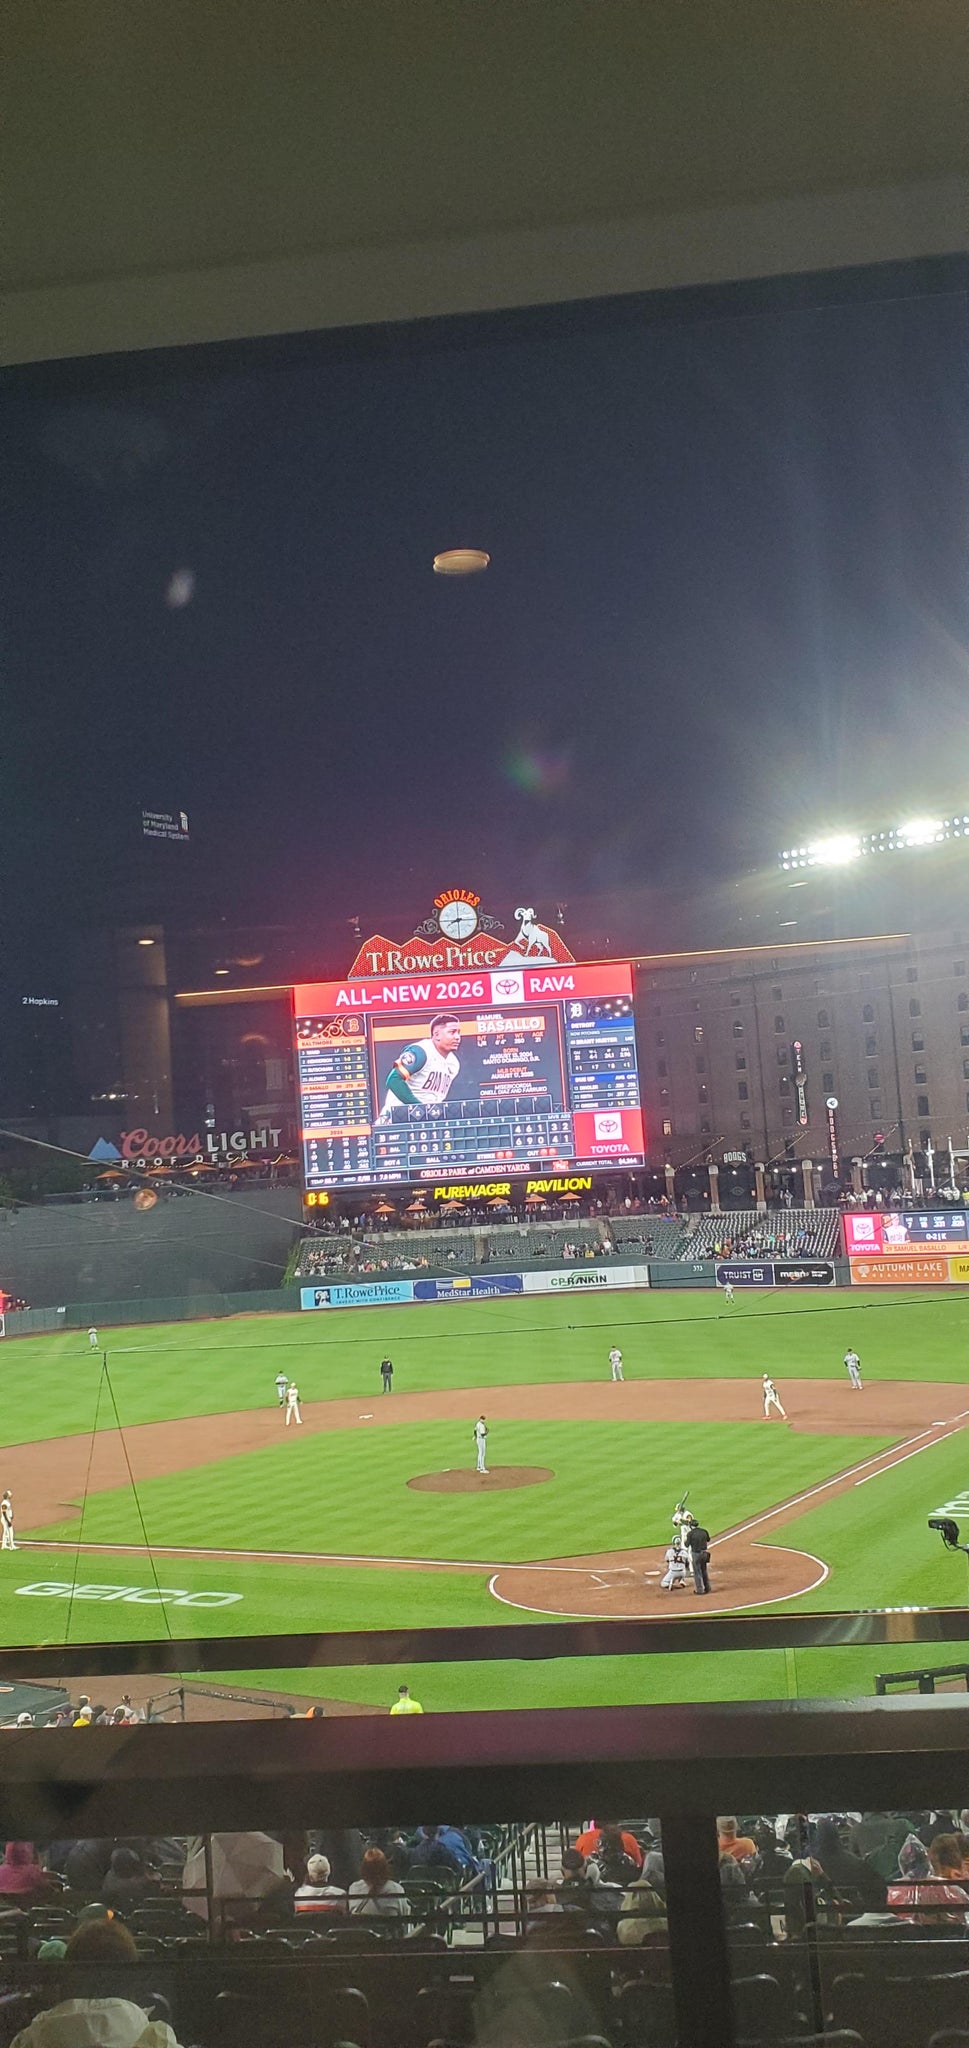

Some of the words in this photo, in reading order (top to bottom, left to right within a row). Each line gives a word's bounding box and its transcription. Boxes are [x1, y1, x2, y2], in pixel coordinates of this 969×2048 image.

[142, 811, 173, 823] University
[151, 821, 179, 831] Maryland
[143, 828, 167, 838] Medical
[168, 832, 190, 841] System
[434, 889, 480, 908] ORIOLES
[445, 946, 496, 968] Price
[435, 980, 484, 1001] 2026
[529, 975, 576, 993] RAV4
[22, 997, 28, 1005] 2
[29, 997, 59, 1007] Hopkins
[477, 1018, 541, 1033] BASALLO
[420, 1132, 427, 1140] 0
[432, 1131, 437, 1139] 1
[443, 1130, 451, 1138] 2
[514, 1125, 521, 1133] 4
[551, 1123, 558, 1131] 3
[562, 1122, 569, 1130] 2
[120, 1128, 203, 1159] Coors
[206, 1128, 282, 1153] LIGHT
[409, 1145, 416, 1153] 0
[420, 1144, 427, 1152] 0
[432, 1143, 439, 1151] 3
[444, 1143, 451, 1151] 3
[526, 1137, 533, 1145] 9
[537, 1136, 544, 1144] 0
[552, 1135, 559, 1143] 4
[563, 1134, 569, 1142] 1
[590, 1143, 630, 1154] TOYOTA
[121, 1156, 177, 1169] ROOF
[195, 1151, 249, 1164] DECK
[420, 1168, 449, 1178] ORIOLE
[448, 1167, 468, 1176] PARK
[475, 1165, 507, 1175] CAMDEN
[506, 1163, 530, 1173] YARDS
[433, 1182, 511, 1200] PUREWAGER
[526, 1177, 593, 1193] PAVILION
[941, 1232, 947, 1240] K
[849, 1243, 881, 1252] TOYOTA
[872, 1263, 914, 1272] AUTUMN
[917, 1262, 942, 1272] LAKE
[567, 1274, 607, 1286] RANKIN
[723, 1271, 752, 1279] TRUIST
[373, 1285, 400, 1297] Price
[437, 1287, 471, 1298] MedStar
[472, 1286, 501, 1296] Health
[14, 1582, 244, 1608] GEICO
